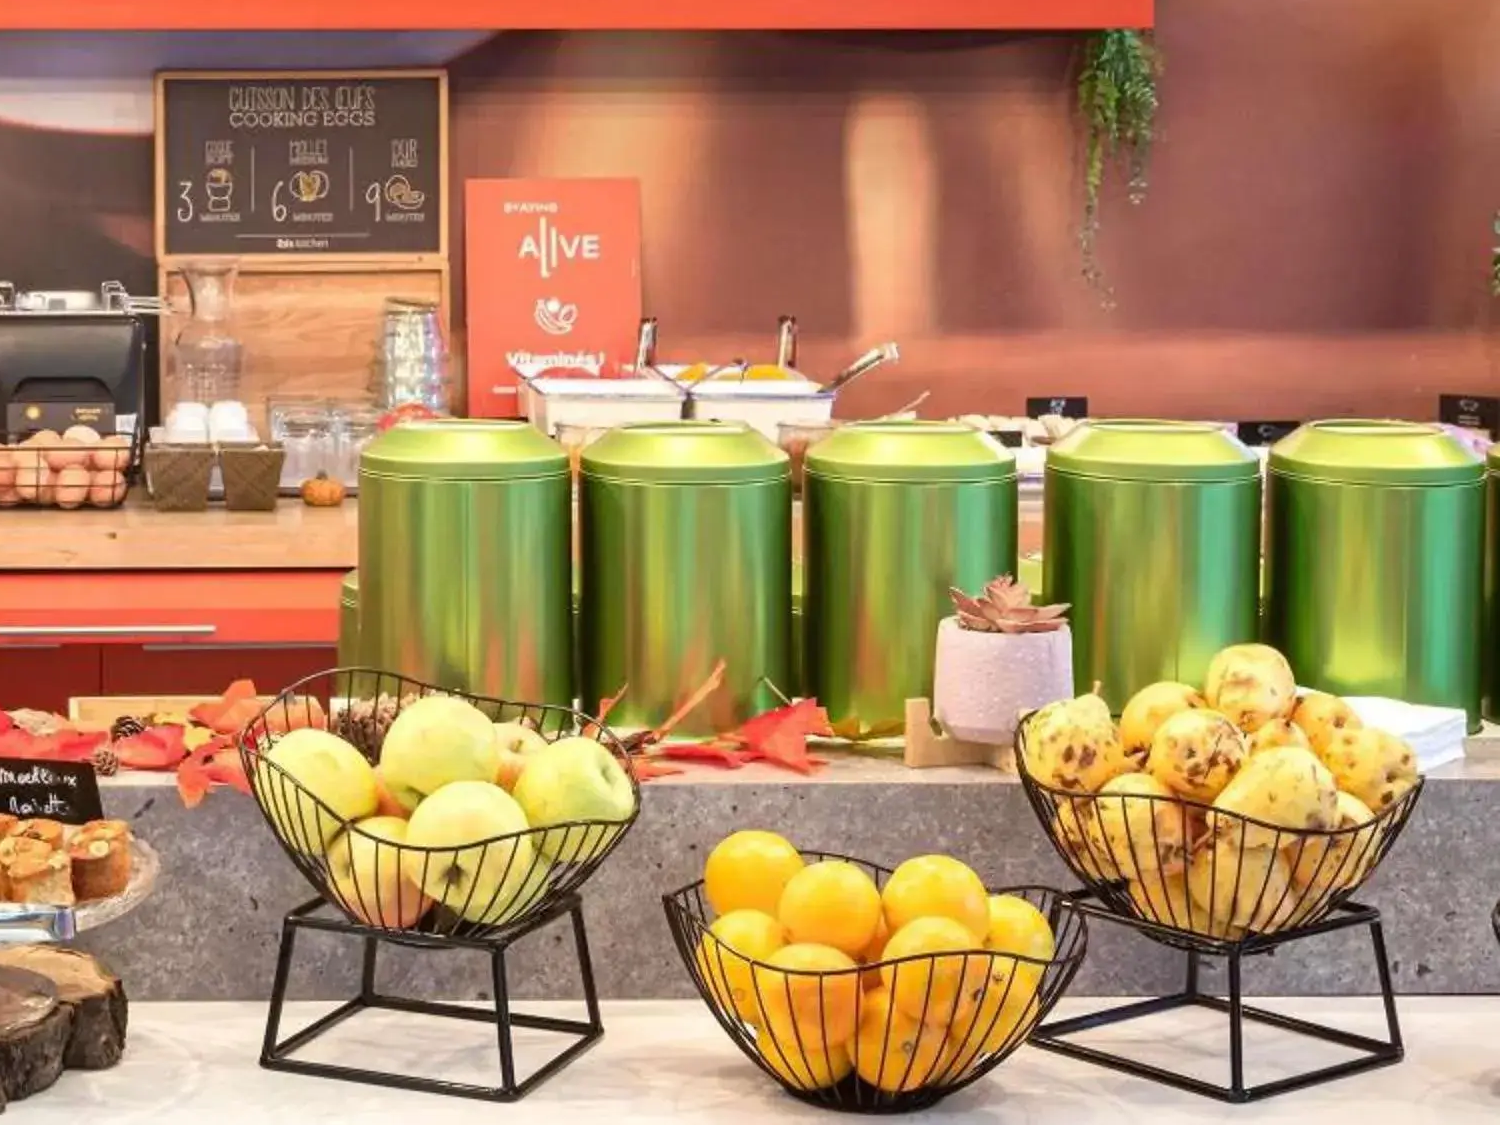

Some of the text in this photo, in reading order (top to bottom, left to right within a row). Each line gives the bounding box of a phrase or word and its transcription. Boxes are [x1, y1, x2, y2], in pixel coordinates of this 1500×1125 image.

[228, 86, 296, 111] CUISSON
[301, 86, 331, 111] DES
[229, 111, 376, 127] COOKING EGGS
[177, 180, 194, 222] 3
[271, 180, 287, 222] 6
[365, 181, 382, 222] 9
